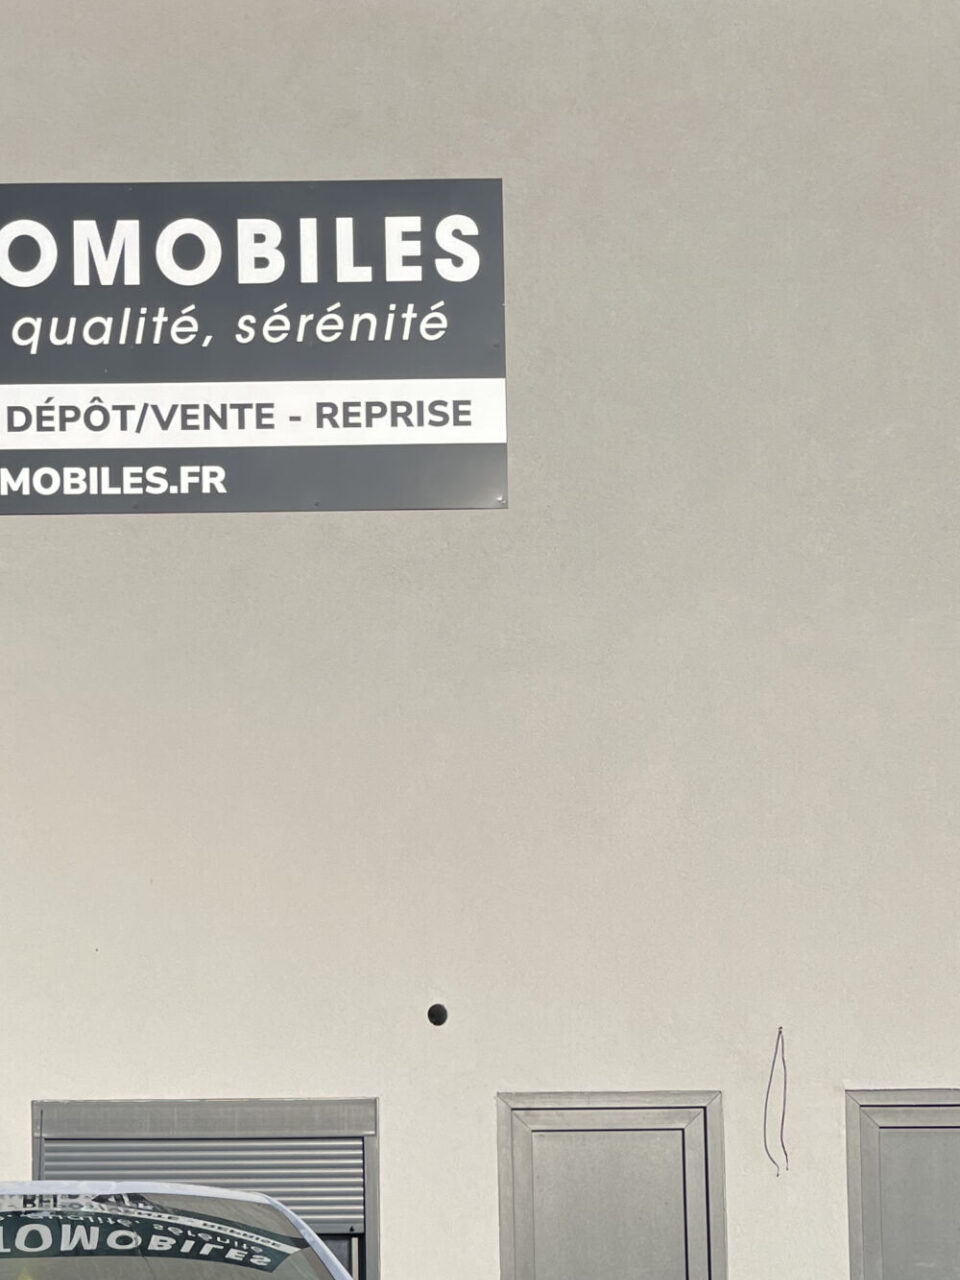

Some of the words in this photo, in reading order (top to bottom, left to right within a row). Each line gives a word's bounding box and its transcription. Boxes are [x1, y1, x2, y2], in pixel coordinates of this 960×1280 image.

[10, 303, 215, 355] qualité,
[234, 300, 450, 344] sérénité
[6, 396, 276, 435] DÉPÔT/VENTE
[315, 399, 473, 430] REPRISE
